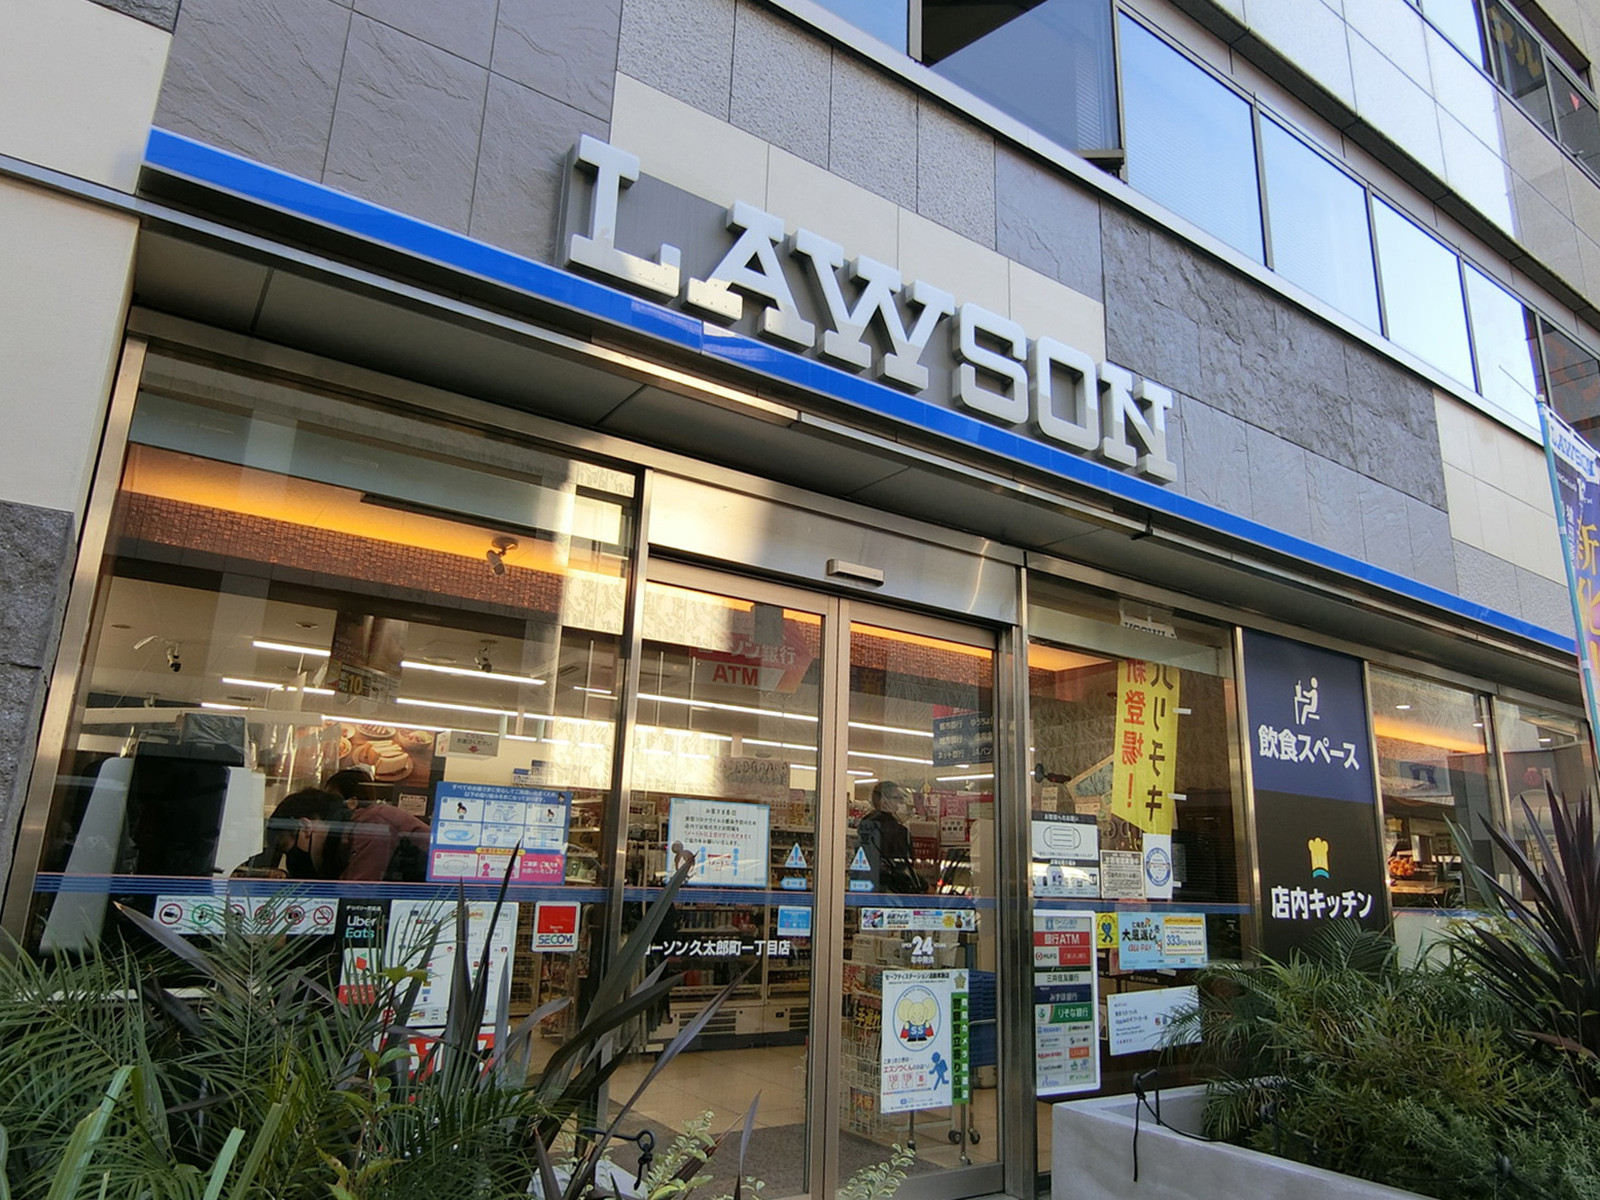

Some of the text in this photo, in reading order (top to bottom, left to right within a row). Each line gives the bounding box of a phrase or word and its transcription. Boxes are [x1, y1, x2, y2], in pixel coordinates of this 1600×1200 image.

[563, 133, 1176, 484] LAWSON
[713, 664, 759, 686] ATM
[1258, 724, 1360, 770] 飲食スペース
[1270, 885, 1374, 920] 店内キッチン
[347, 915, 377, 927] Uber
[345, 927, 375, 938] Eats
[538, 934, 573, 944] SECOM
[912, 935, 933, 955] 24
[1044, 933, 1080, 945] 銀行ATM
[645, 939, 791, 957] ーソン久太郎町一丁目店
[1046, 973, 1080, 983] 三井住友銀行
[1049, 992, 1078, 1002] みずほ銀行
[1057, 1007, 1089, 1018] りそな銀行
[910, 1025, 924, 1035] SS
